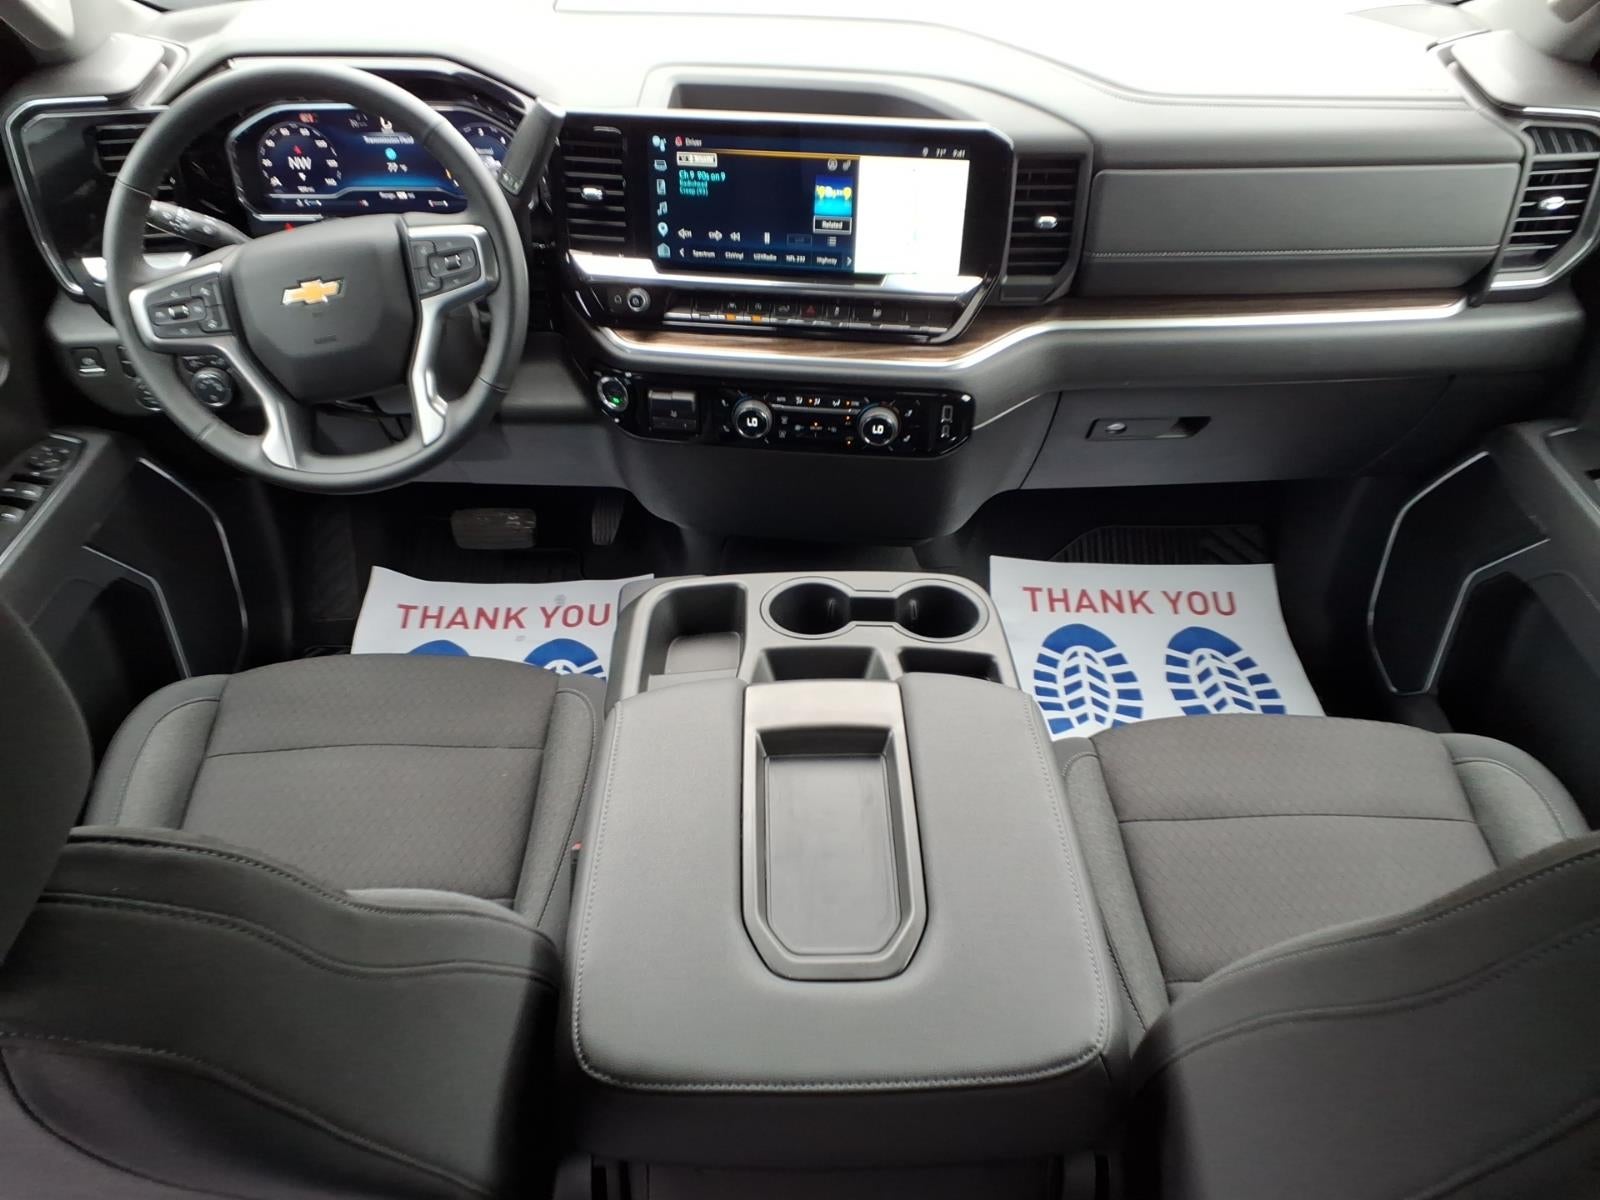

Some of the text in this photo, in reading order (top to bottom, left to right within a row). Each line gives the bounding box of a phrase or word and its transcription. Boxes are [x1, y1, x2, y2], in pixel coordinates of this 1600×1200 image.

[287, 156, 312, 170] NW
[710, 172, 720, 181] on
[821, 220, 843, 229] Related
[872, 424, 884, 435] LO
[1022, 587, 1237, 616] THANK YOU
[397, 603, 611, 630] THANK YOU
